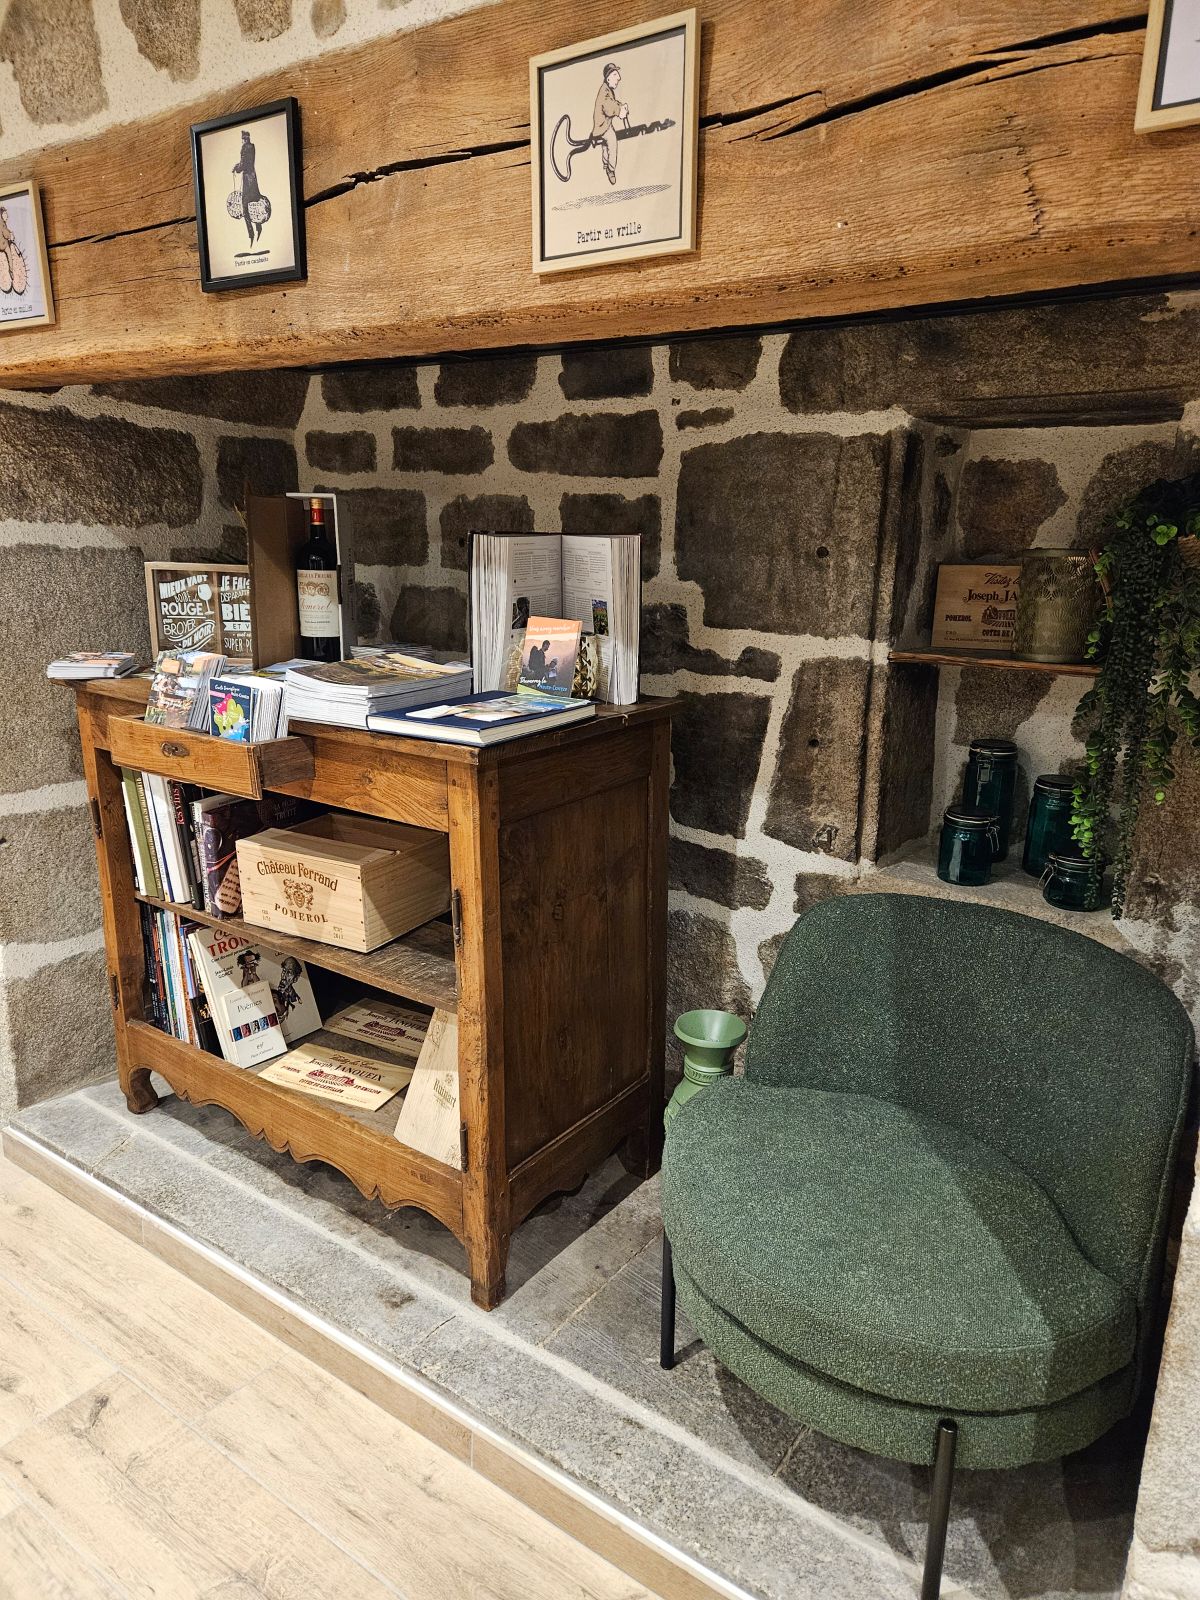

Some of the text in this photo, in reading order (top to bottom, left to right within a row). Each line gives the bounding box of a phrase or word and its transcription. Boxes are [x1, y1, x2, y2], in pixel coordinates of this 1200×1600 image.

[577, 221, 642, 244] Partir en vrille
[159, 578, 187, 600] MIEUX
[186, 574, 208, 588] VAUT
[220, 575, 231, 592] JE
[963, 588, 999, 603] Joseph
[161, 601, 204, 616] ROUGE
[221, 600, 251, 621] BIÈ
[945, 614, 972, 622] POMEROL
[163, 618, 196, 636] BROYER
[181, 624, 212, 649] DU NOIR
[223, 637, 244, 653] SUPER
[256, 860, 338, 892] Château Ferrand
[274, 902, 329, 924] POMEROL
[387, 1017, 429, 1033] JANOUEI
[305, 1058, 385, 1082] Joseph JANOUEIX
